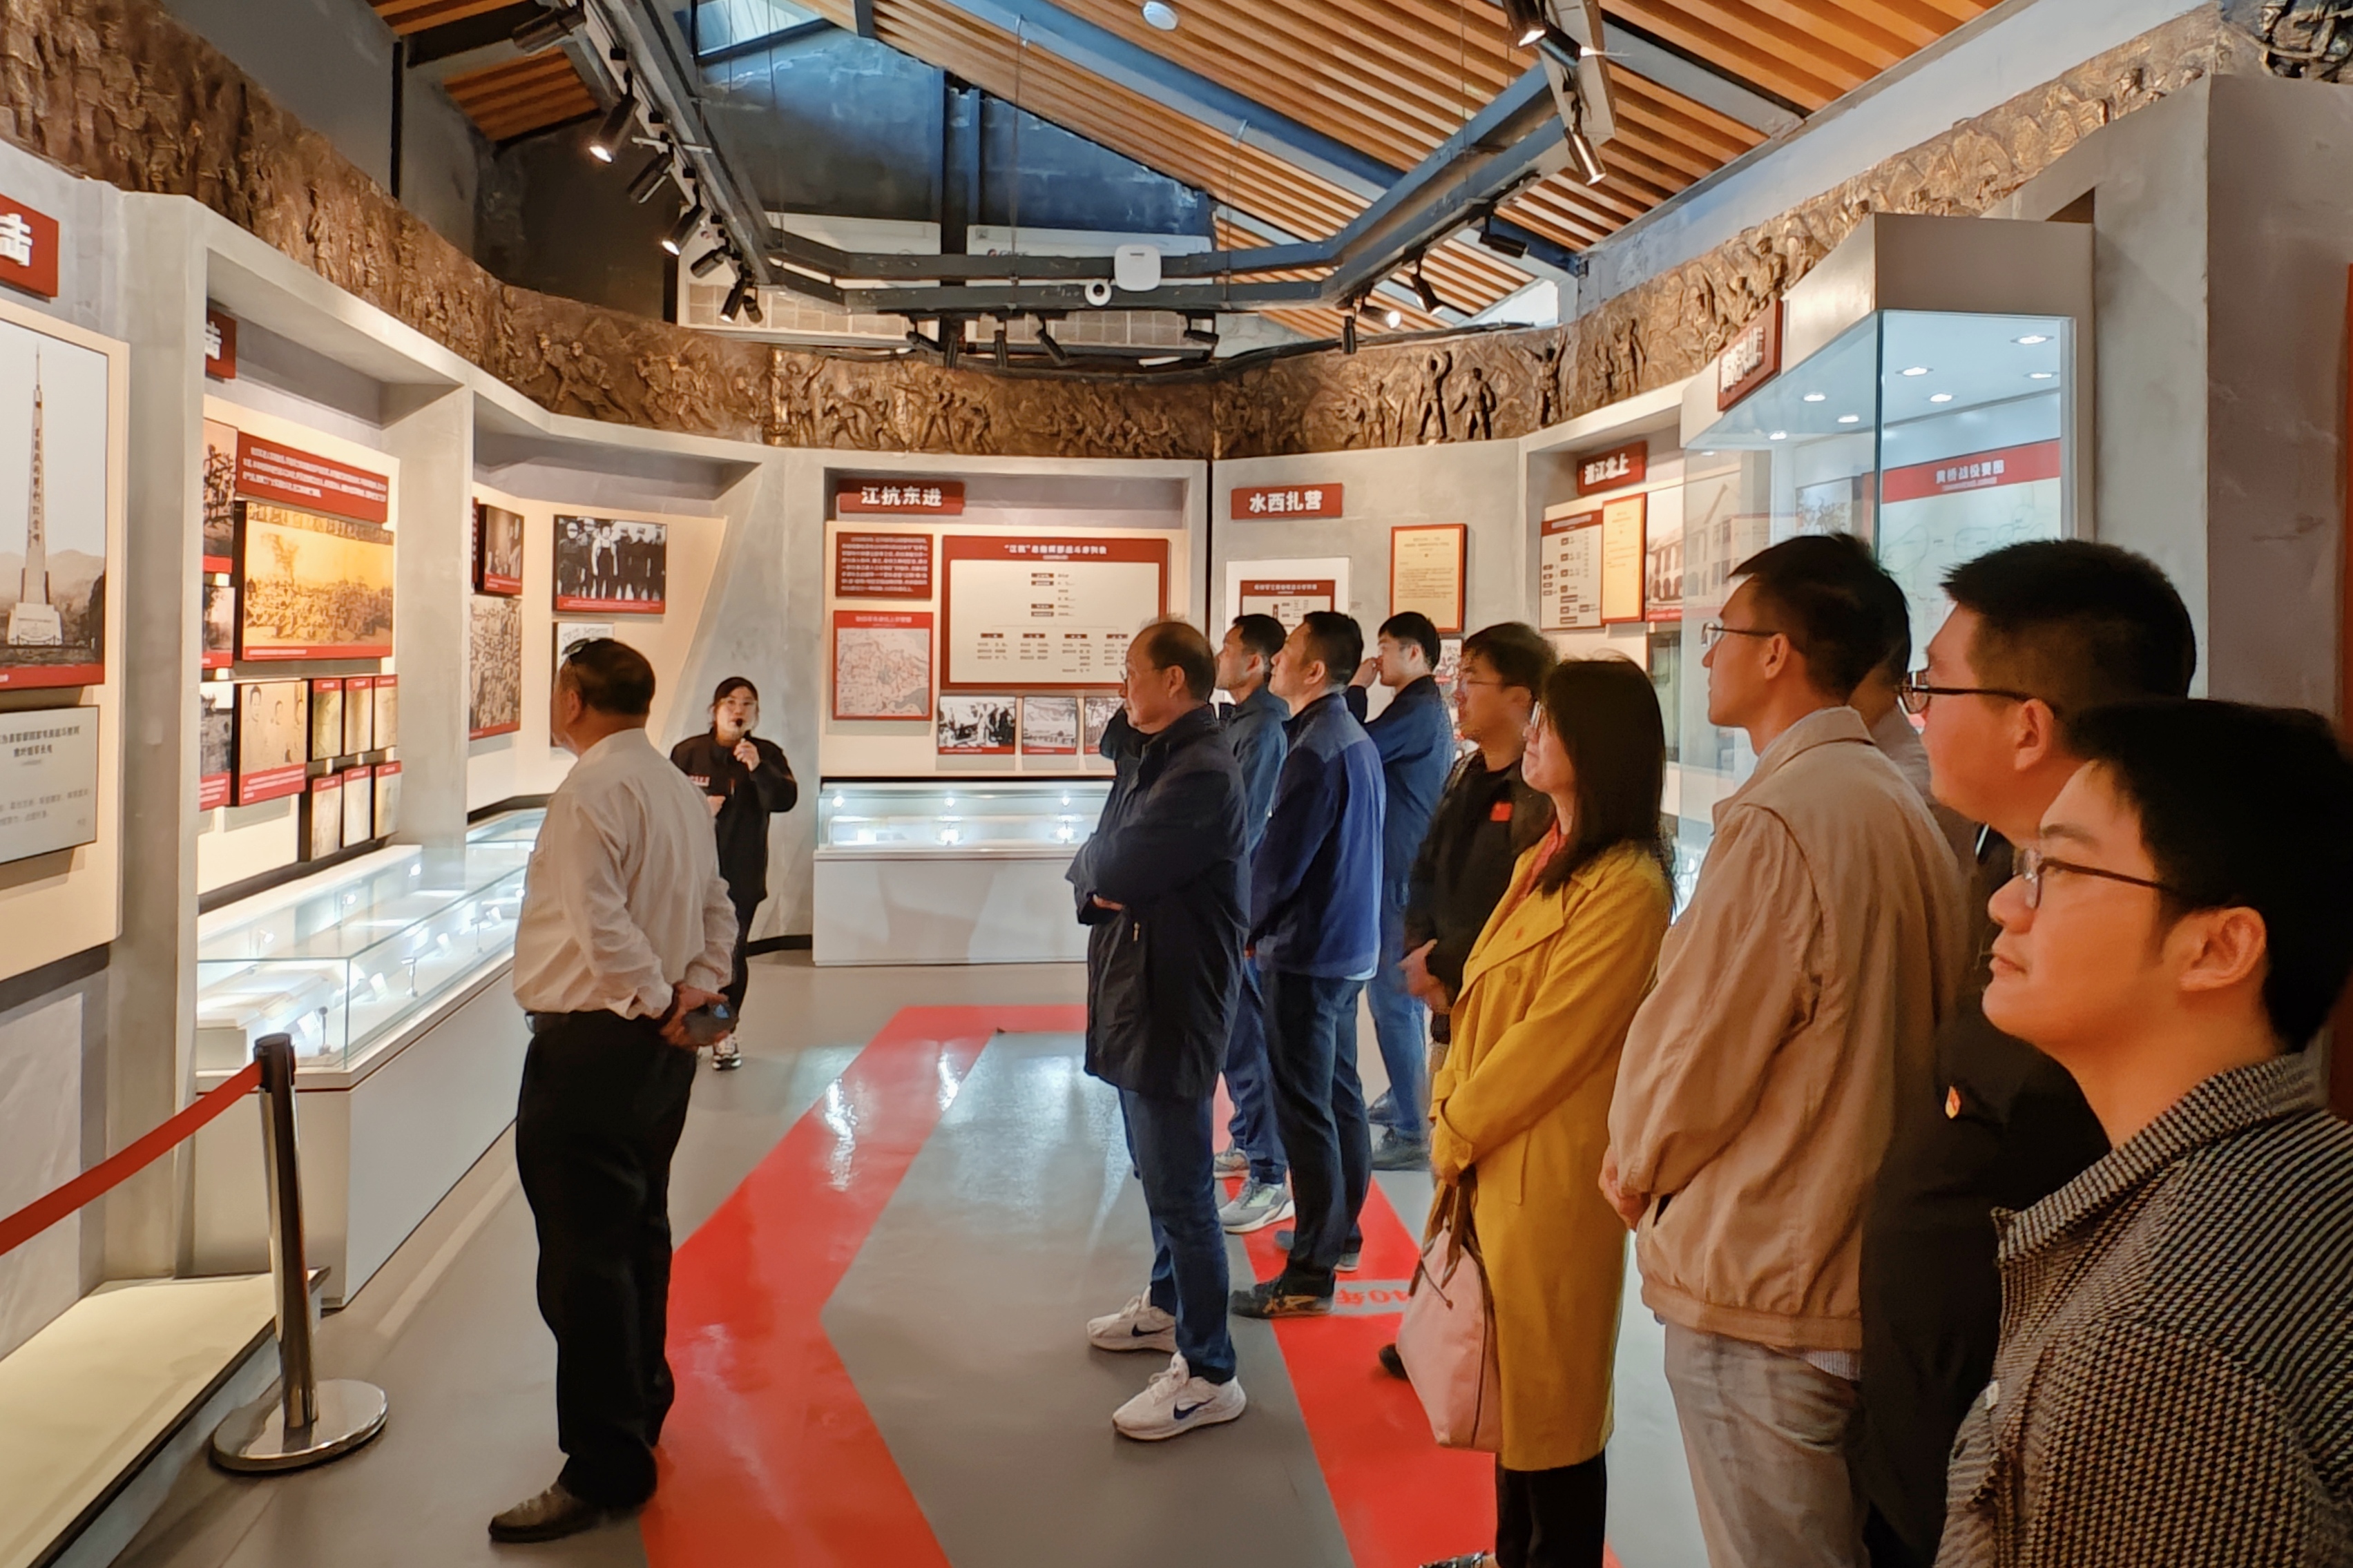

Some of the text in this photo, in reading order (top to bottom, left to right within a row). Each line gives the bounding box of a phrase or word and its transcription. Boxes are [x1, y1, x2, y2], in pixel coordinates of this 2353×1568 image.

[861, 485, 942, 507] 江抗东进
[1249, 490, 1323, 513] 水西扎营
